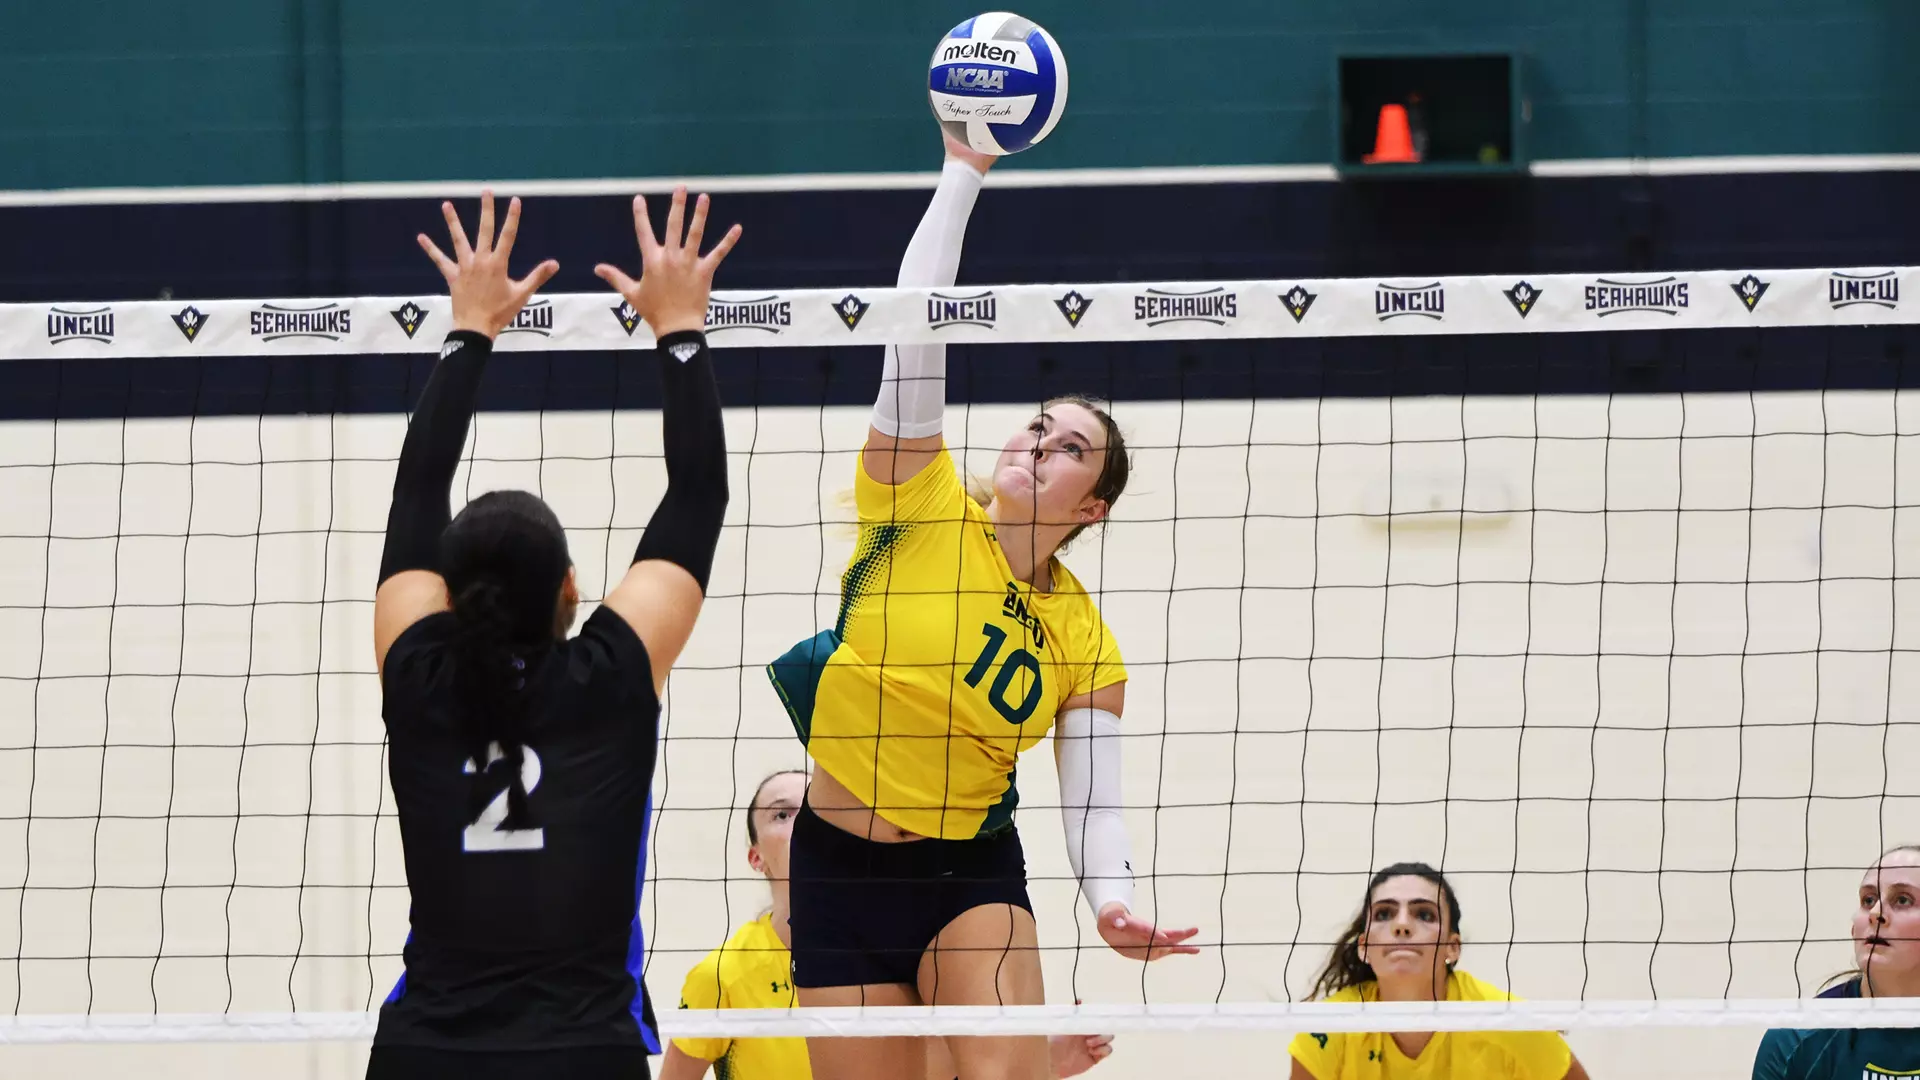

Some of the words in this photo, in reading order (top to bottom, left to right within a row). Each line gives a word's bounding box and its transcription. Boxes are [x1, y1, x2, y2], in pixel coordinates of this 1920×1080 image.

[943, 42, 1016, 65] molten
[945, 67, 1004, 90] NCAA
[942, 99, 971, 117] Super
[975, 104, 1012, 117] Touch
[1376, 289, 1444, 314] UNCW
[1585, 283, 1688, 310] SEAHAWKS
[1830, 278, 1899, 303] UNCW
[704, 302, 791, 325] EAHAWKS
[928, 298, 996, 323] UNCW
[1135, 294, 1237, 320] SEAHAWKS
[48, 314, 114, 337] UNCW
[251, 310, 351, 335] SEAHAWKS
[963, 622, 1043, 724] 10
[462, 739, 545, 852] 2
